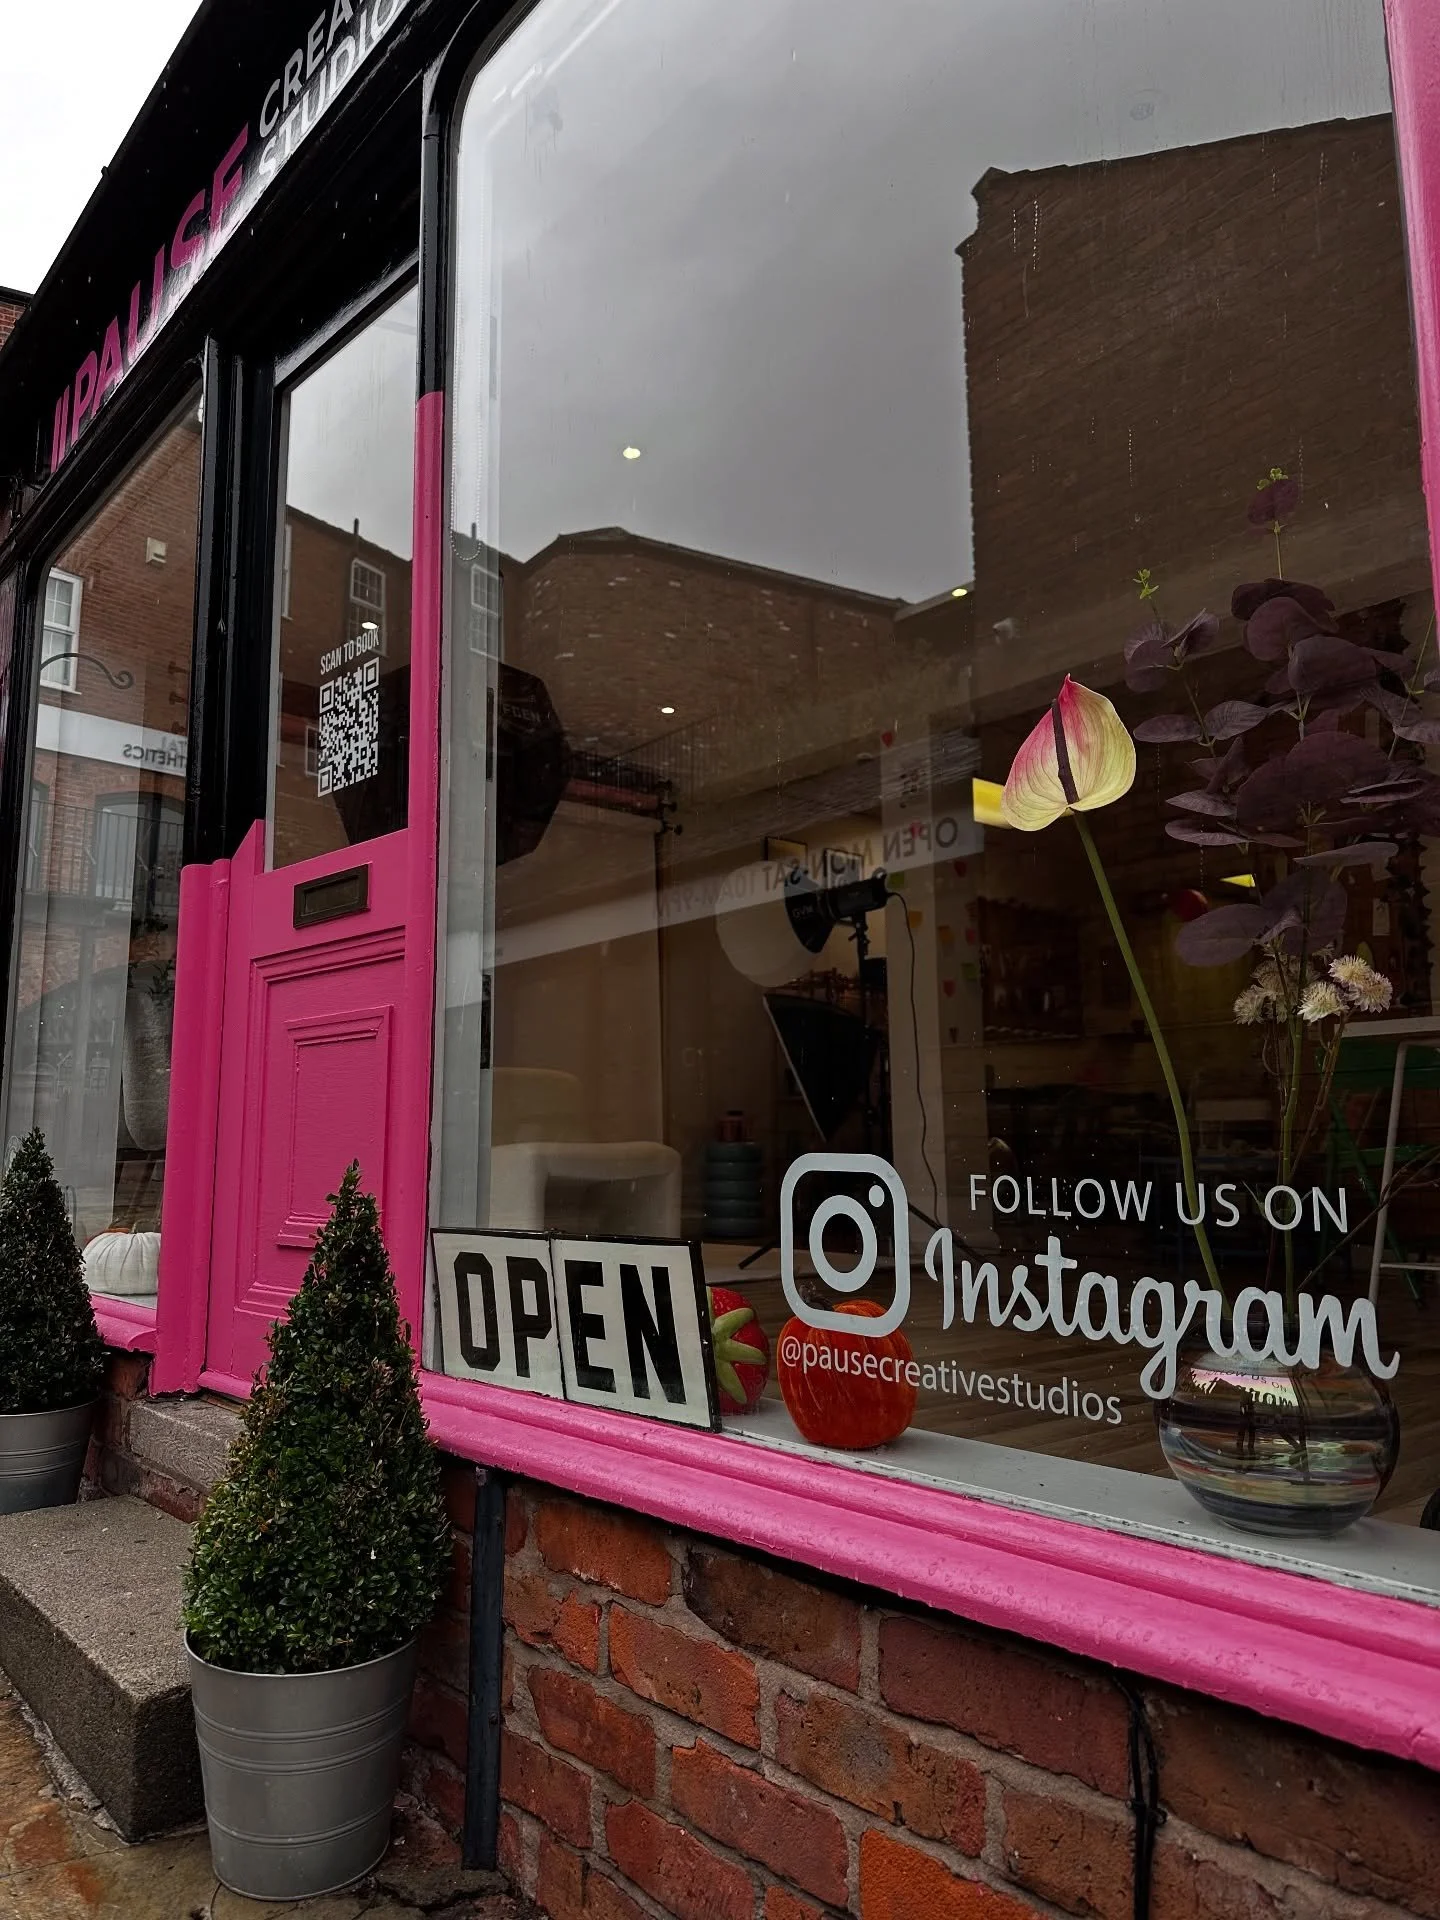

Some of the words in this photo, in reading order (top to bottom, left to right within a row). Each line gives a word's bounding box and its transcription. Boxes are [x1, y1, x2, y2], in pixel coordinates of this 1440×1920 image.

[259, 0, 363, 138] CREA
[69, 121, 249, 445] PAUSE
[320, 646, 342, 676] SCAN
[343, 639, 354, 663] TO
[356, 626, 380, 657] BOOK
[968, 1173, 1153, 1222] FOLLOW
[1175, 1180, 1240, 1229] US
[1263, 1185, 1349, 1233] ON
[453, 1251, 687, 1405] OPEN
[780, 1335, 1123, 1425] @pausecreativestudios
[924, 1227, 1400, 1400] Instagram
